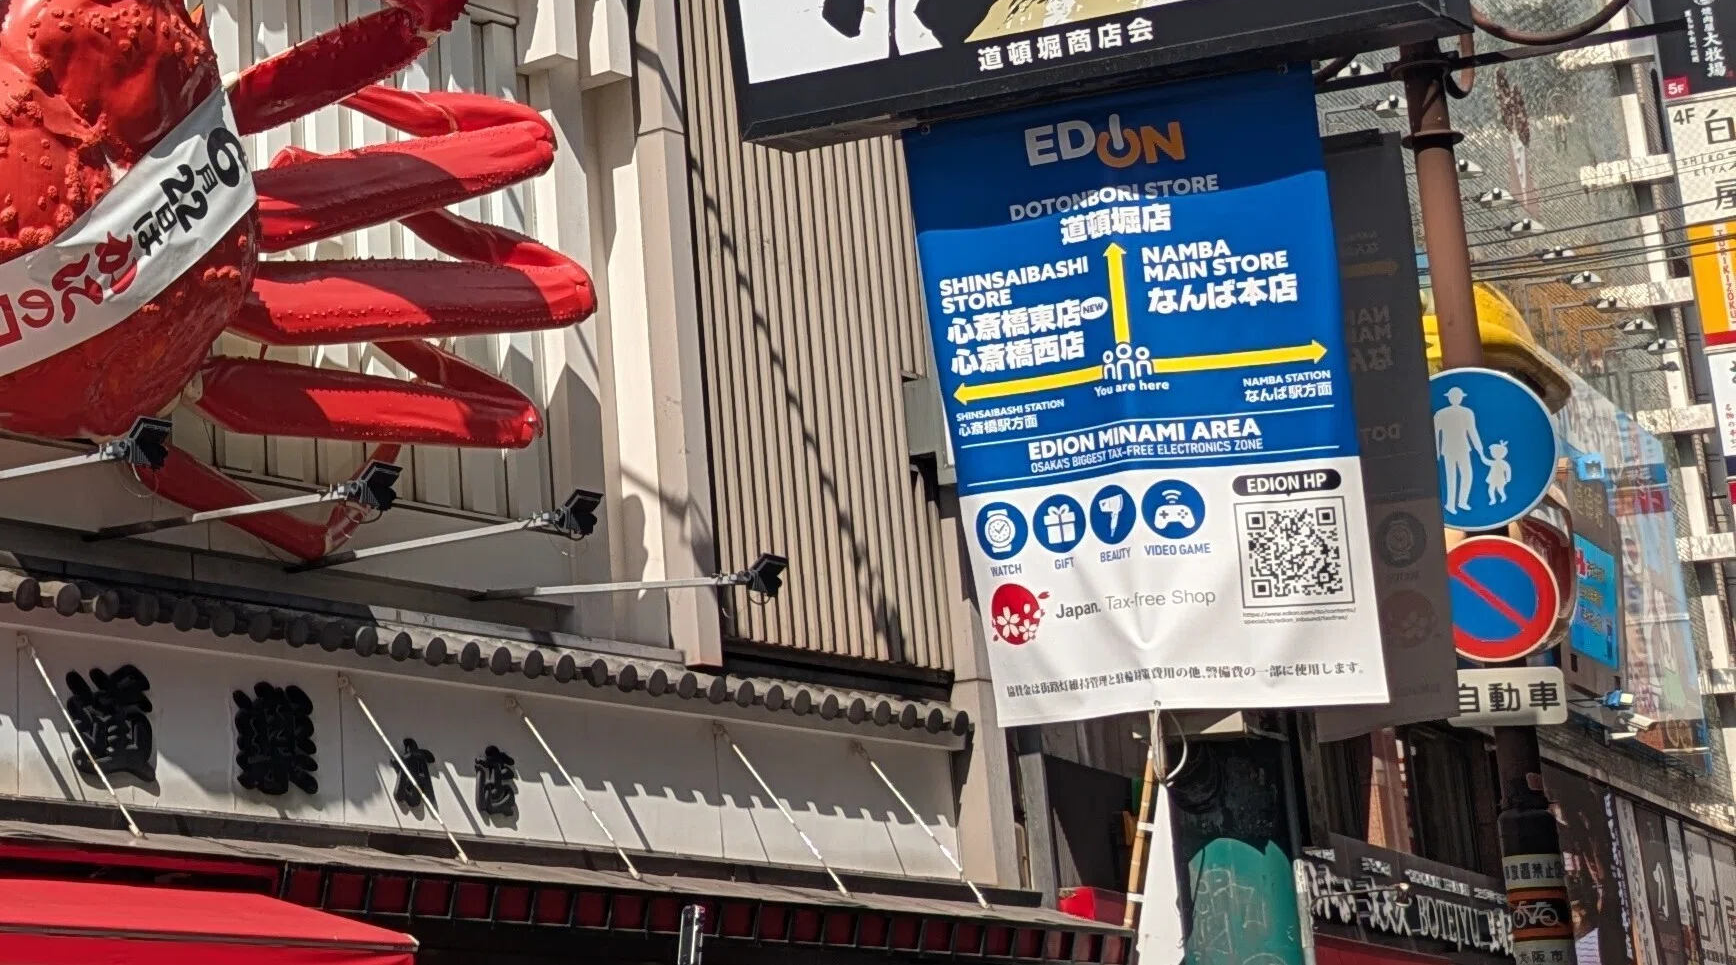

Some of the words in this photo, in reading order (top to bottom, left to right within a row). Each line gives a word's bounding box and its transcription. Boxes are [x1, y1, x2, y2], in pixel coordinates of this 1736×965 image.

[977, 17, 1154, 72] 道頓堀商店会
[1668, 82, 1685, 96] 5F
[1673, 107, 1696, 126] 4F
[1024, 114, 1186, 168] EDION
[1009, 186, 1140, 222] DOTONBORI
[1145, 174, 1219, 199] STORE
[1060, 203, 1172, 245] 道頓堀店
[1141, 239, 1231, 264] NAMBA
[939, 256, 1089, 296] SHINSAIBASHI
[1143, 260, 1208, 283] MAIN
[1212, 250, 1289, 277] STORE
[942, 288, 1013, 314] STORE
[1148, 273, 1298, 315] なんば本店
[1082, 302, 1105, 315] NEW
[1094, 385, 1114, 398] You
[1116, 382, 1136, 393] are
[1139, 380, 1169, 391] here
[1243, 374, 1283, 388] NAMBA
[1285, 370, 1332, 384] STATION
[1244, 381, 1333, 403] なんば駅方面
[956, 405, 1024, 422] SHINSAIBASHI
[1025, 398, 1065, 413] STATION
[1028, 432, 1095, 461] EDION
[1098, 423, 1186, 452] MINAMI
[1191, 418, 1262, 438] AREA
[1031, 456, 1071, 474] OSAKA'S
[1072, 450, 1107, 467] BIGGEST
[1108, 443, 1154, 459] TAX-FREE
[1157, 440, 1232, 456] ELECTRONICS
[1234, 437, 1264, 451] ZONE
[1246, 475, 1300, 493] EDION
[1303, 472, 1327, 489] HP
[1100, 547, 1132, 563] BEAUTY
[1144, 544, 1177, 556] VIDEO
[1179, 542, 1212, 555] GAME
[990, 564, 1022, 577] WATCH
[1054, 556, 1075, 570] GIFT
[1056, 602, 1102, 620] Japan.
[1105, 591, 1166, 611] Tax-free
[1172, 589, 1216, 605] Shop
[1458, 681, 1561, 714] 自動車
